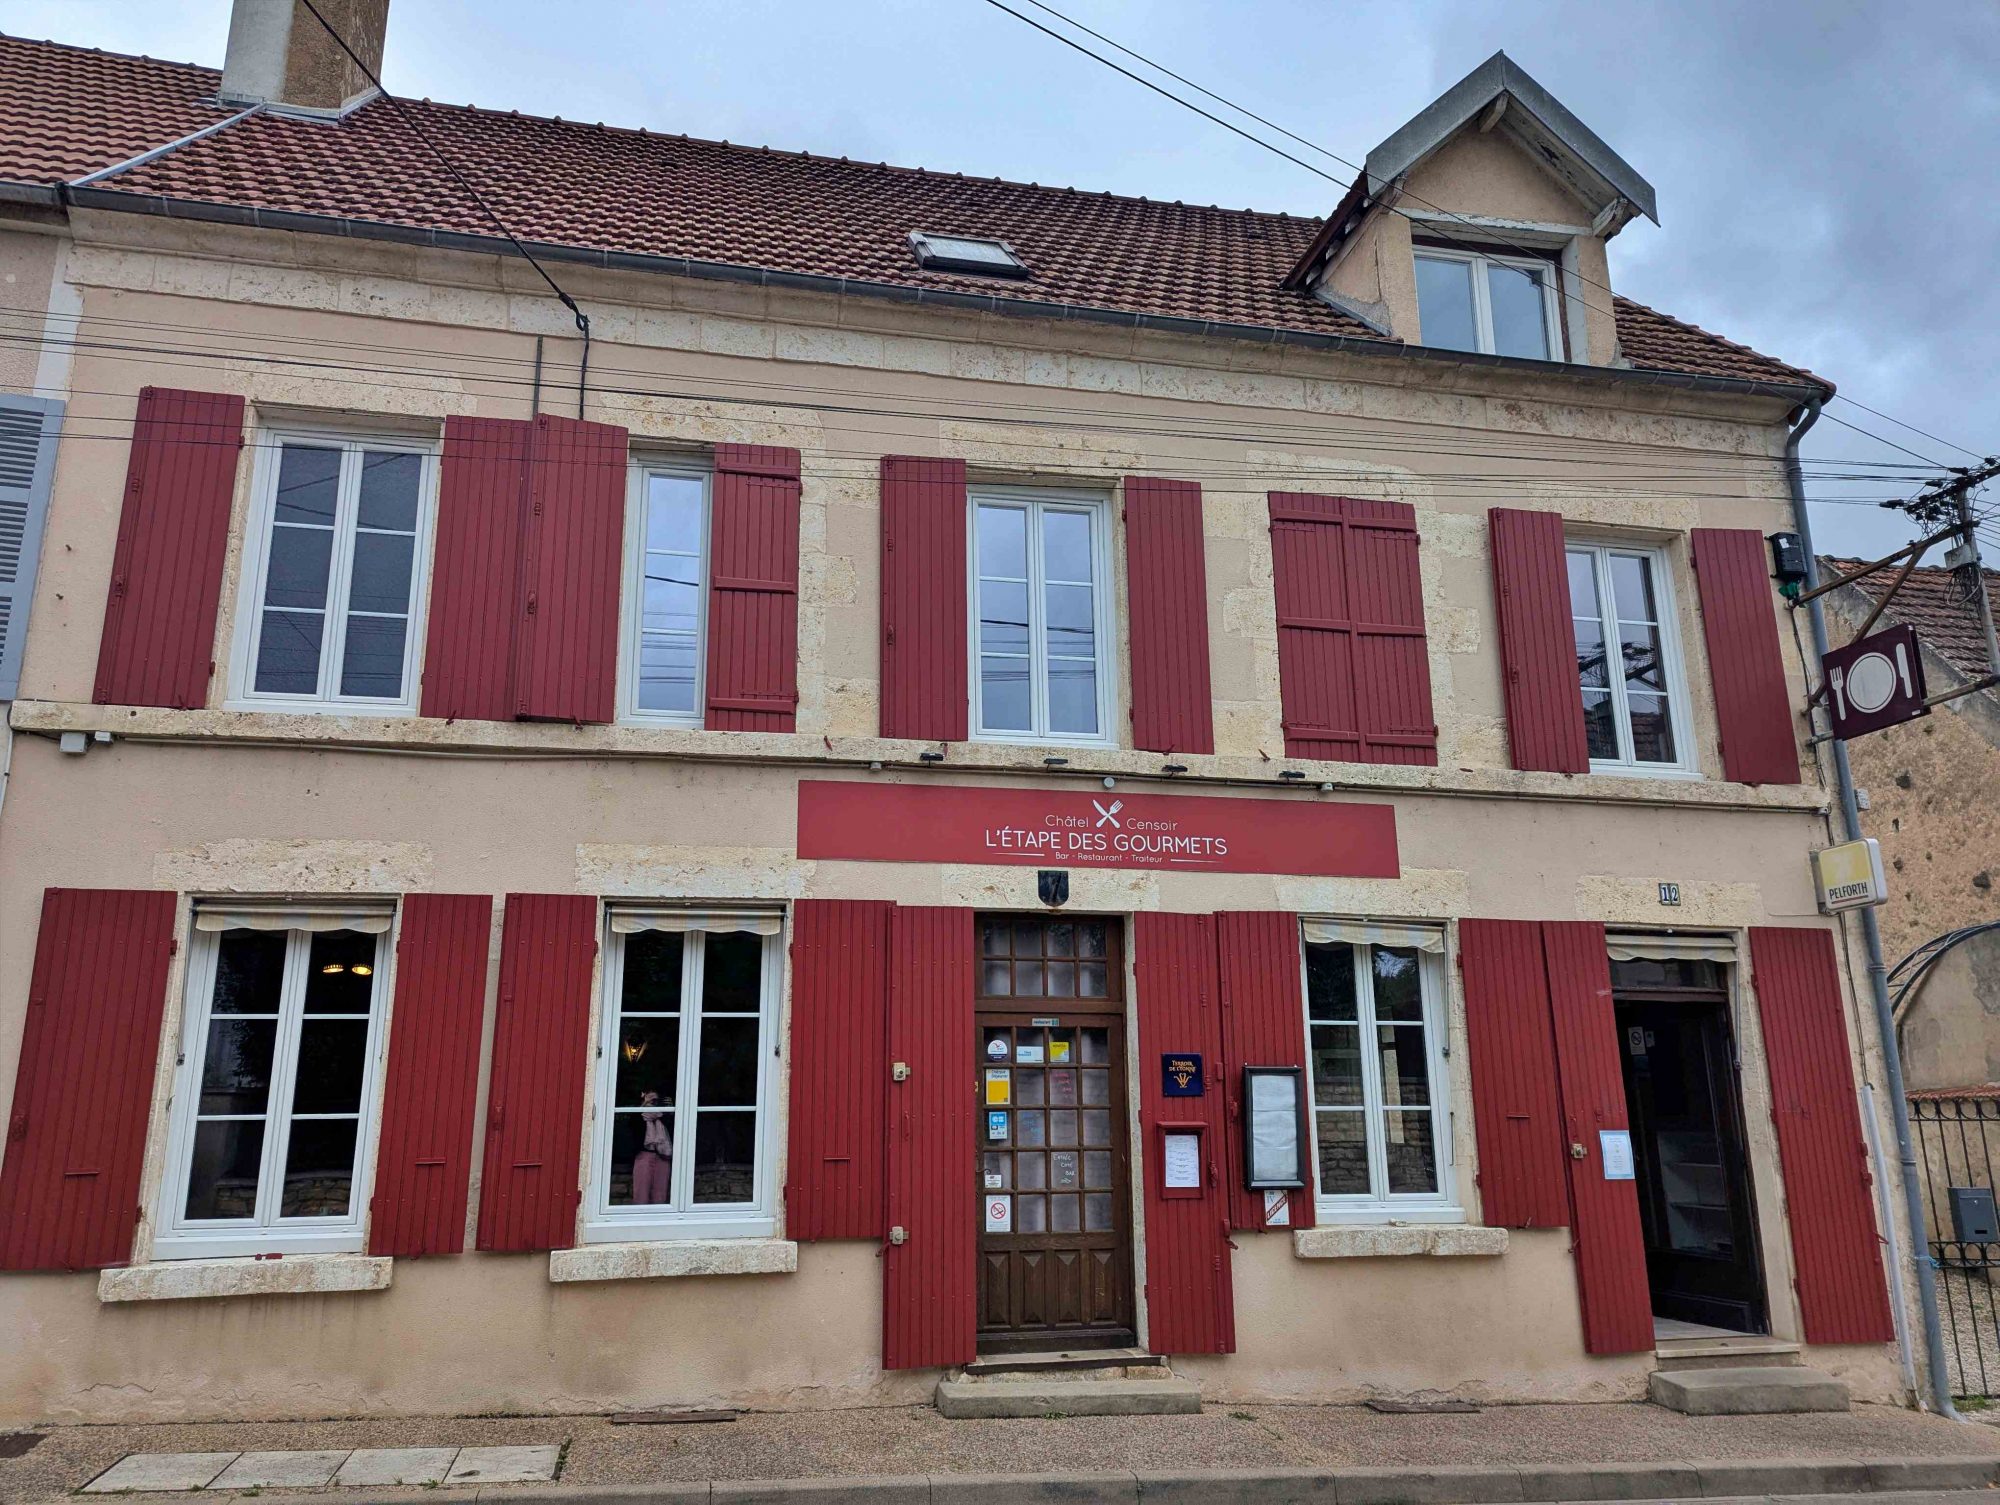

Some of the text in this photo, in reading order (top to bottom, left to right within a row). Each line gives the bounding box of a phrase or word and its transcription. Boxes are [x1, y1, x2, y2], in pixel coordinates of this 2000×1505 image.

[1045, 814, 1178, 831] Châtel Censoir
[986, 825, 1228, 855] L'ÉTAPE DES GOURMETS
[1055, 851, 1069, 860] Bar
[1077, 852, 1123, 862] Restaurant
[1131, 854, 1163, 863] Traiteur
[1662, 886, 1679, 902] 12
[1829, 882, 1868, 900] PELFORTH
